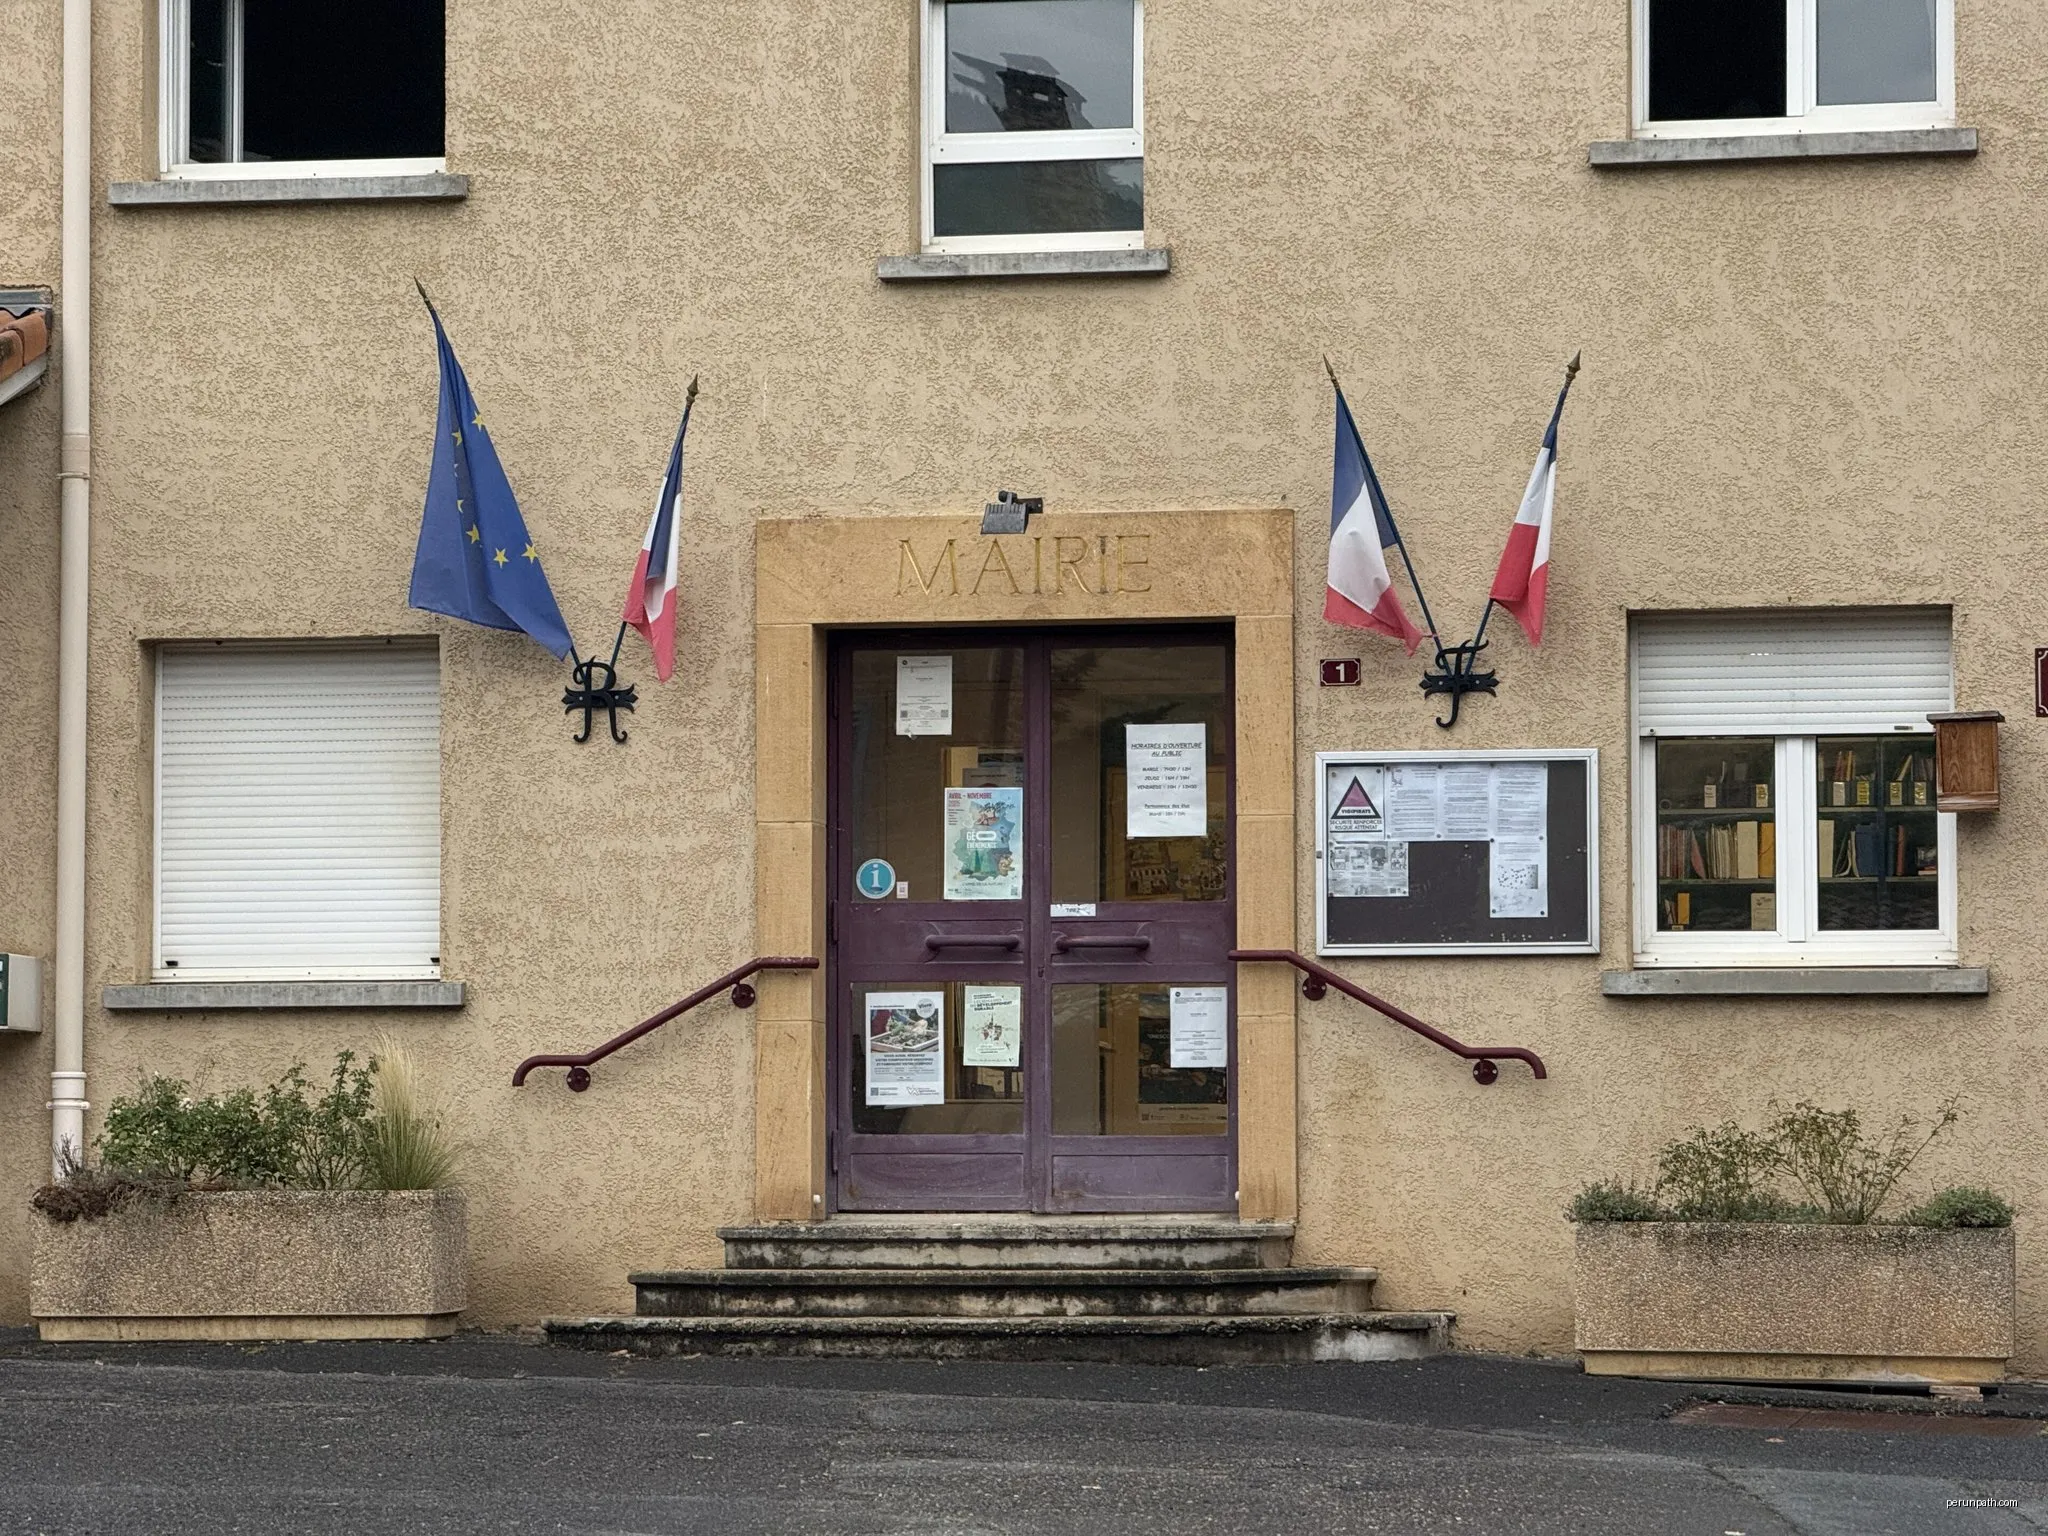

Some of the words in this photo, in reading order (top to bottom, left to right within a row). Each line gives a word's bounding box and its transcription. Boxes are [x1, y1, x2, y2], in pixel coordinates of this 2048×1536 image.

[894, 534, 1152, 598] MAIRIE
[1335, 662, 1345, 682] 1
[1131, 742, 1161, 750] HORAIRES
